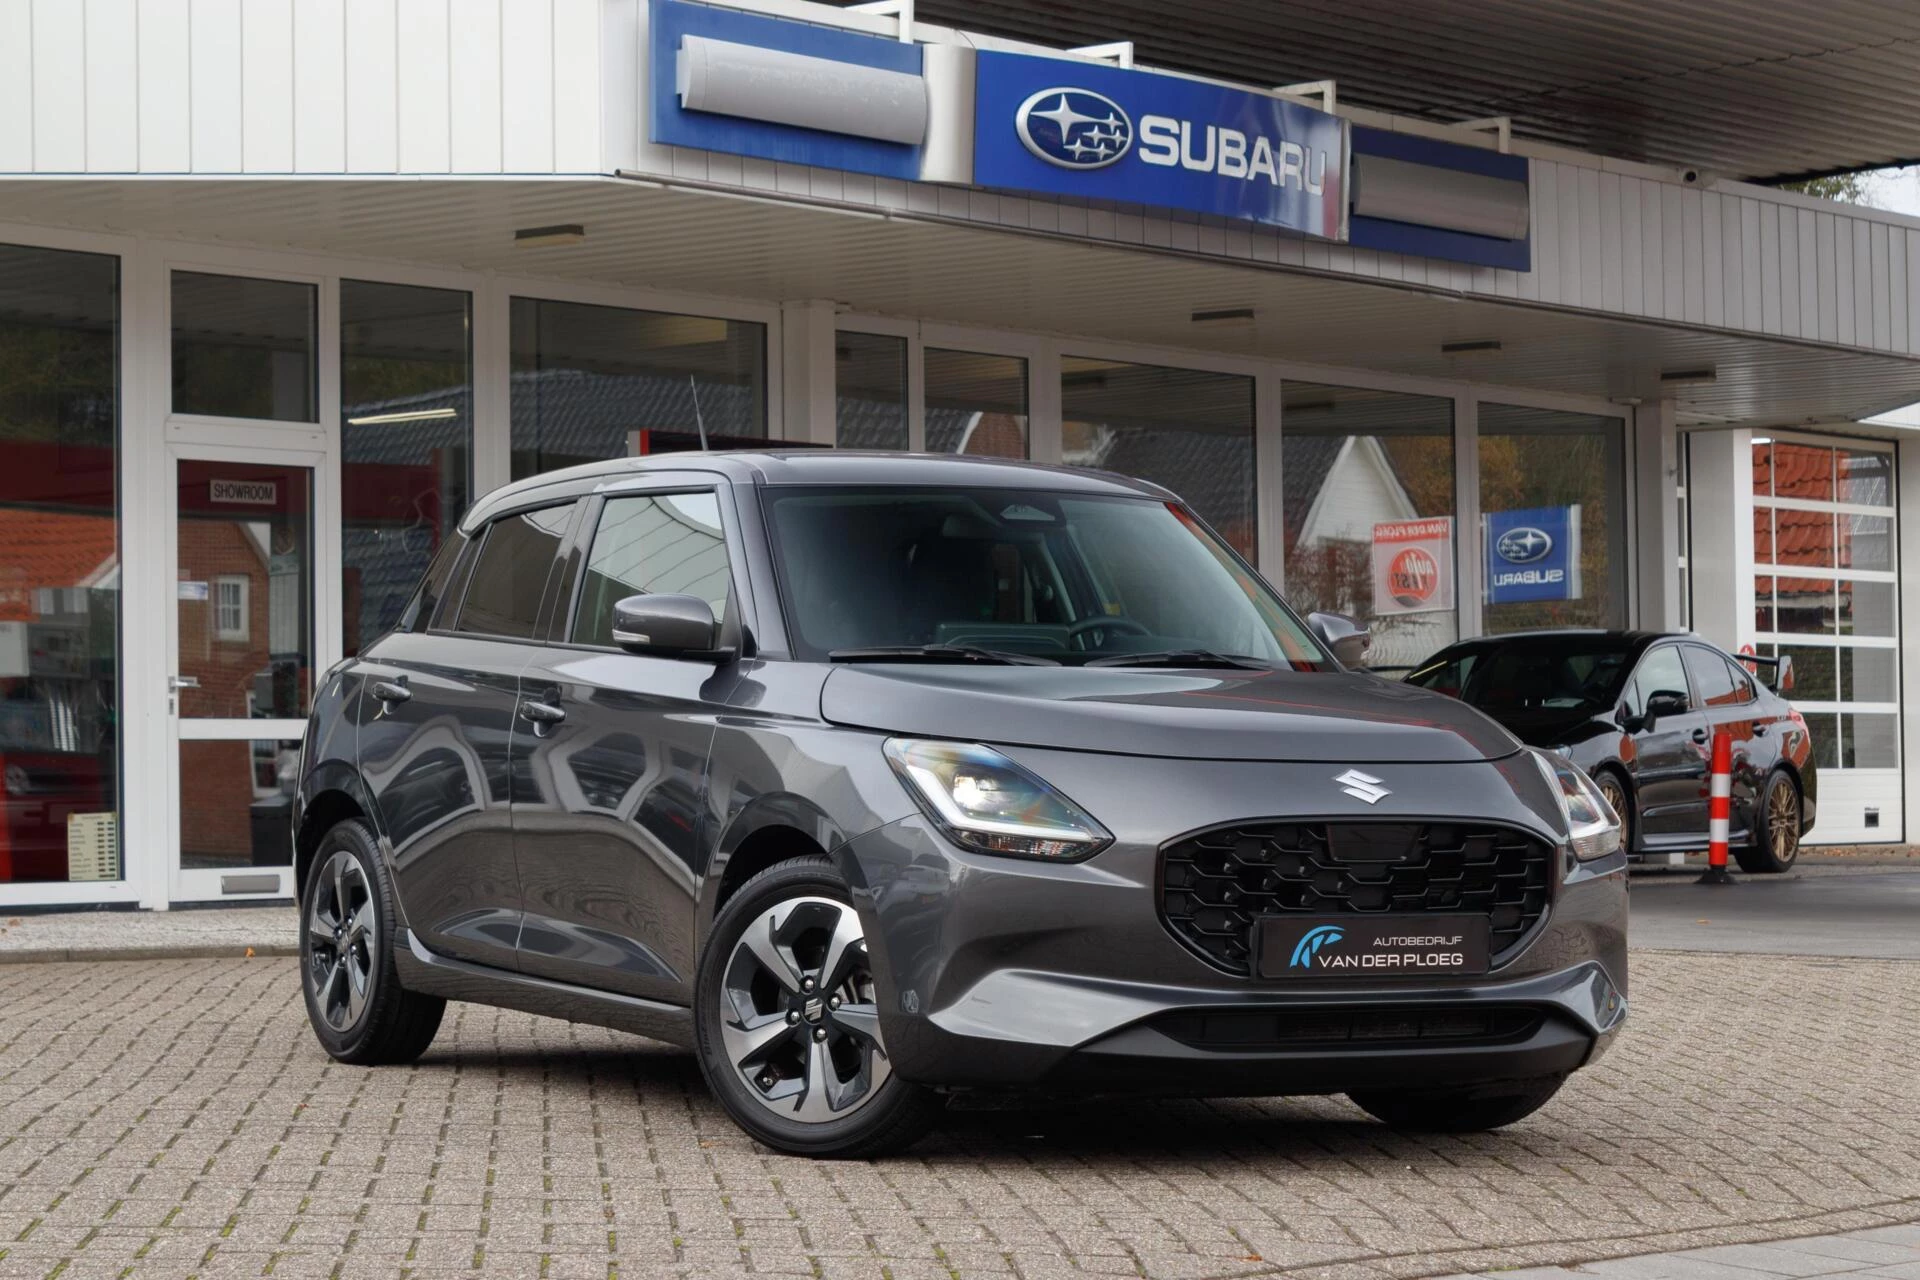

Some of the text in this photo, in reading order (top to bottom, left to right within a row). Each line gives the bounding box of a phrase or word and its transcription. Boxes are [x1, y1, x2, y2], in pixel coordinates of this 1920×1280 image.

[1139, 114, 1326, 196] SUBARU
[214, 483, 273, 500] SHOWROOM
[1373, 936, 1463, 947] AUTOBEDRIJF
[1318, 953, 1463, 968] VAN DER PLOEG
